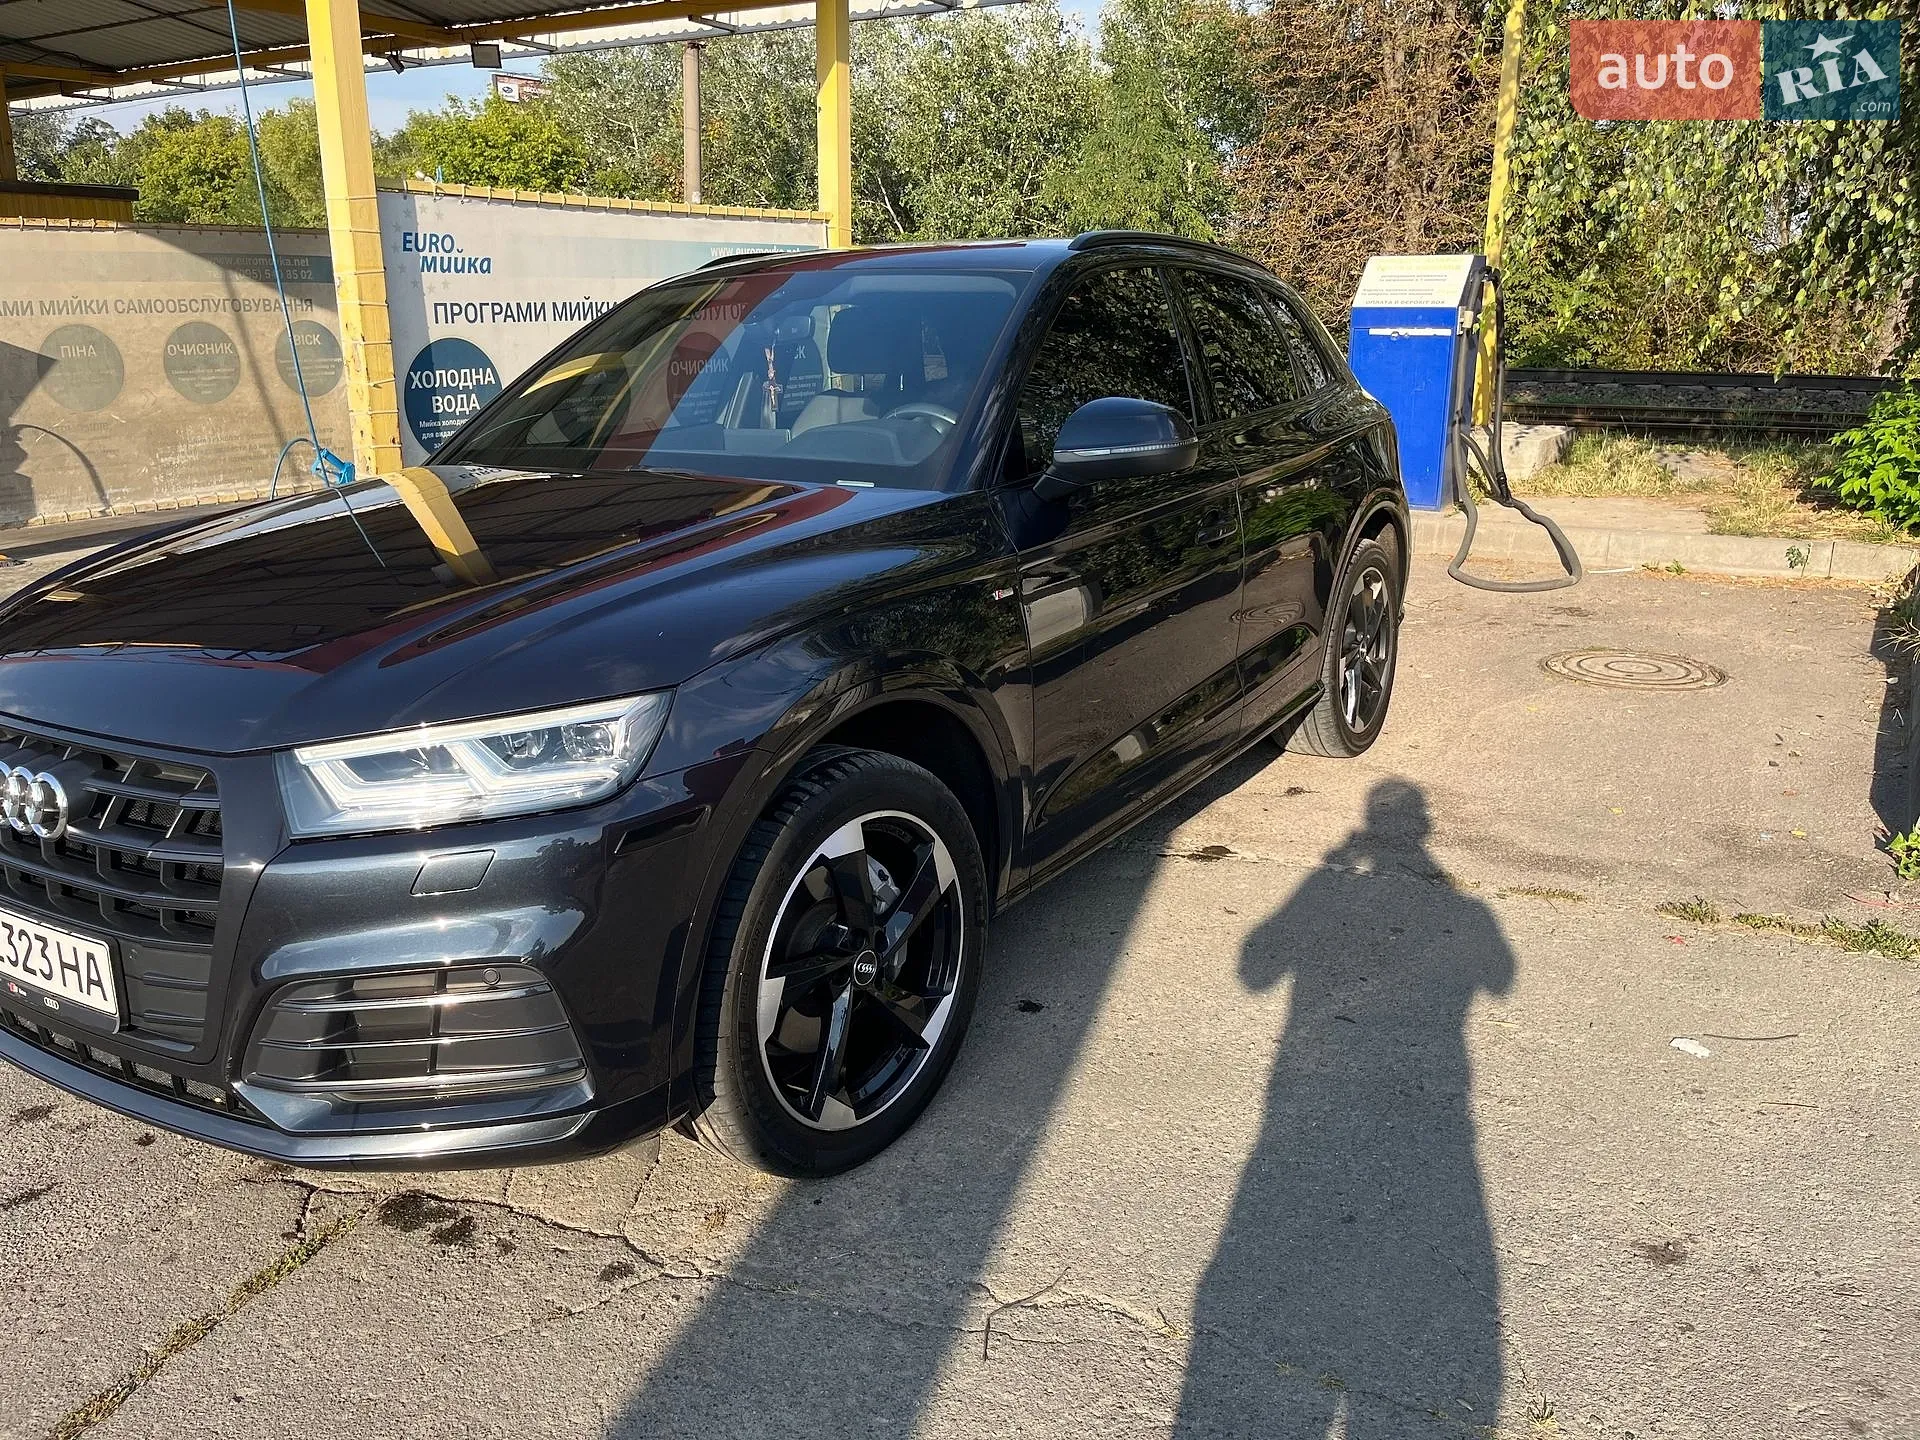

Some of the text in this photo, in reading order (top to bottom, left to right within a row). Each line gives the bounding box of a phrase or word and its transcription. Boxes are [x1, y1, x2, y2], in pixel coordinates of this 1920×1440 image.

[402, 231, 455, 254] EURO
[39, 295, 109, 316] МИЙКИ
[114, 298, 314, 314] САМООБСЛУГОВУВАННЯ
[433, 302, 547, 324] ПРОГРАМИ
[167, 342, 233, 357] ОЧИСНИК
[294, 334, 322, 346] ВІСК
[60, 345, 97, 358] ПІНА
[671, 357, 729, 376] ОЧИСНИК
[410, 367, 496, 390] ХОЛОДНА
[432, 393, 480, 415] ВОДА
